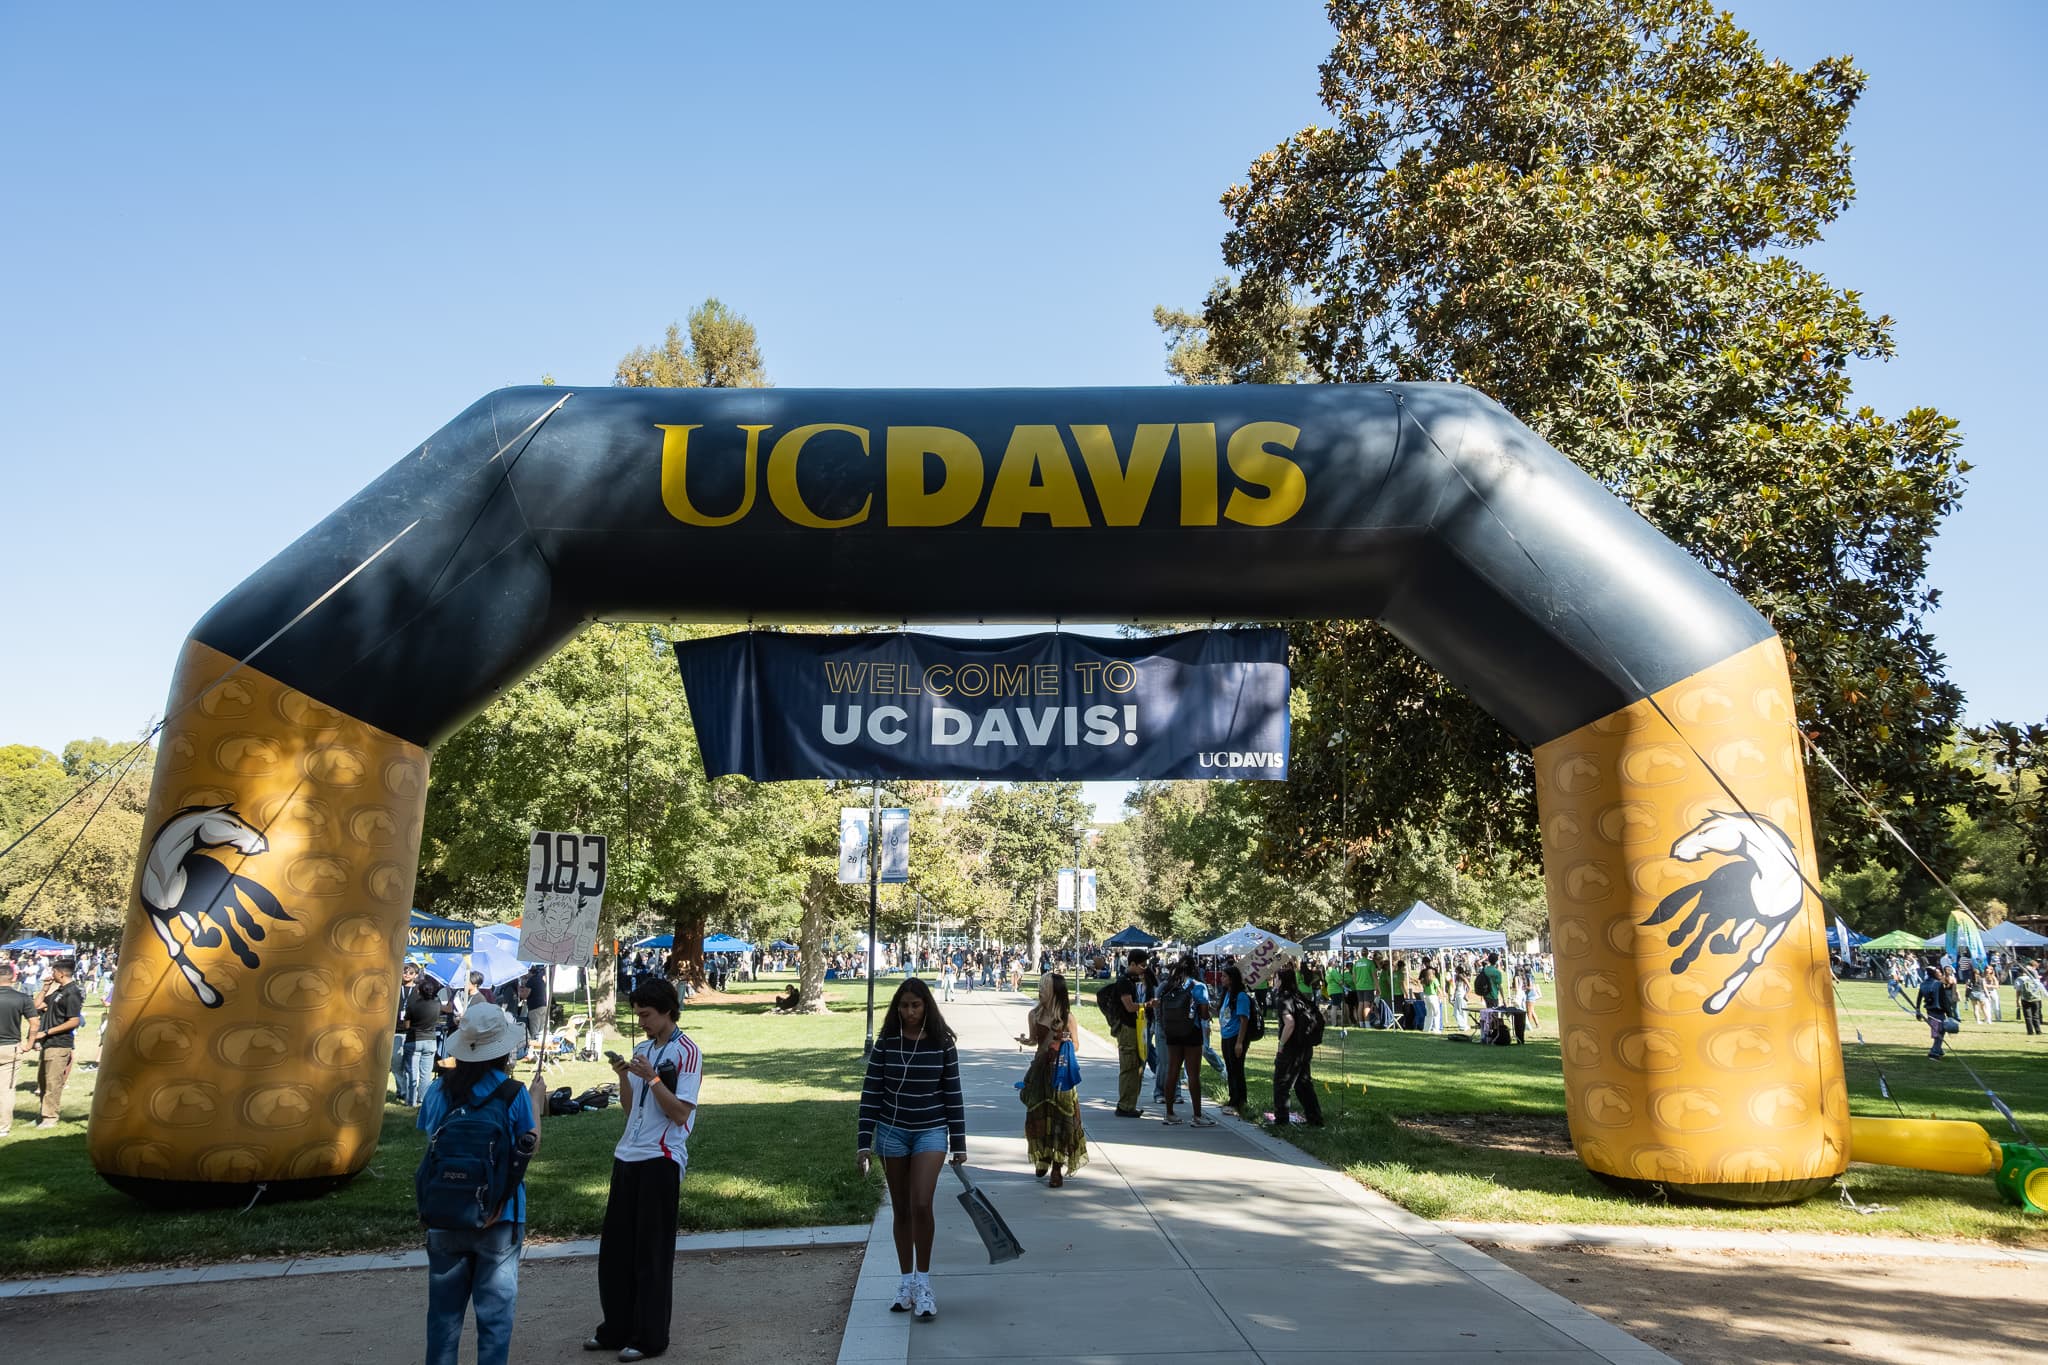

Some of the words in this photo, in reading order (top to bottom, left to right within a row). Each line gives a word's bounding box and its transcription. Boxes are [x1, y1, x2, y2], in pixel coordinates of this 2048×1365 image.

[824, 661, 1059, 697] WELCOME
[1075, 660, 1138, 694] TO
[821, 705, 908, 746] UC
[931, 704, 1138, 746] DAVIS!
[532, 831, 606, 897] 183
[420, 928, 447, 946] ARMY
[448, 929, 471, 948] ROTC
